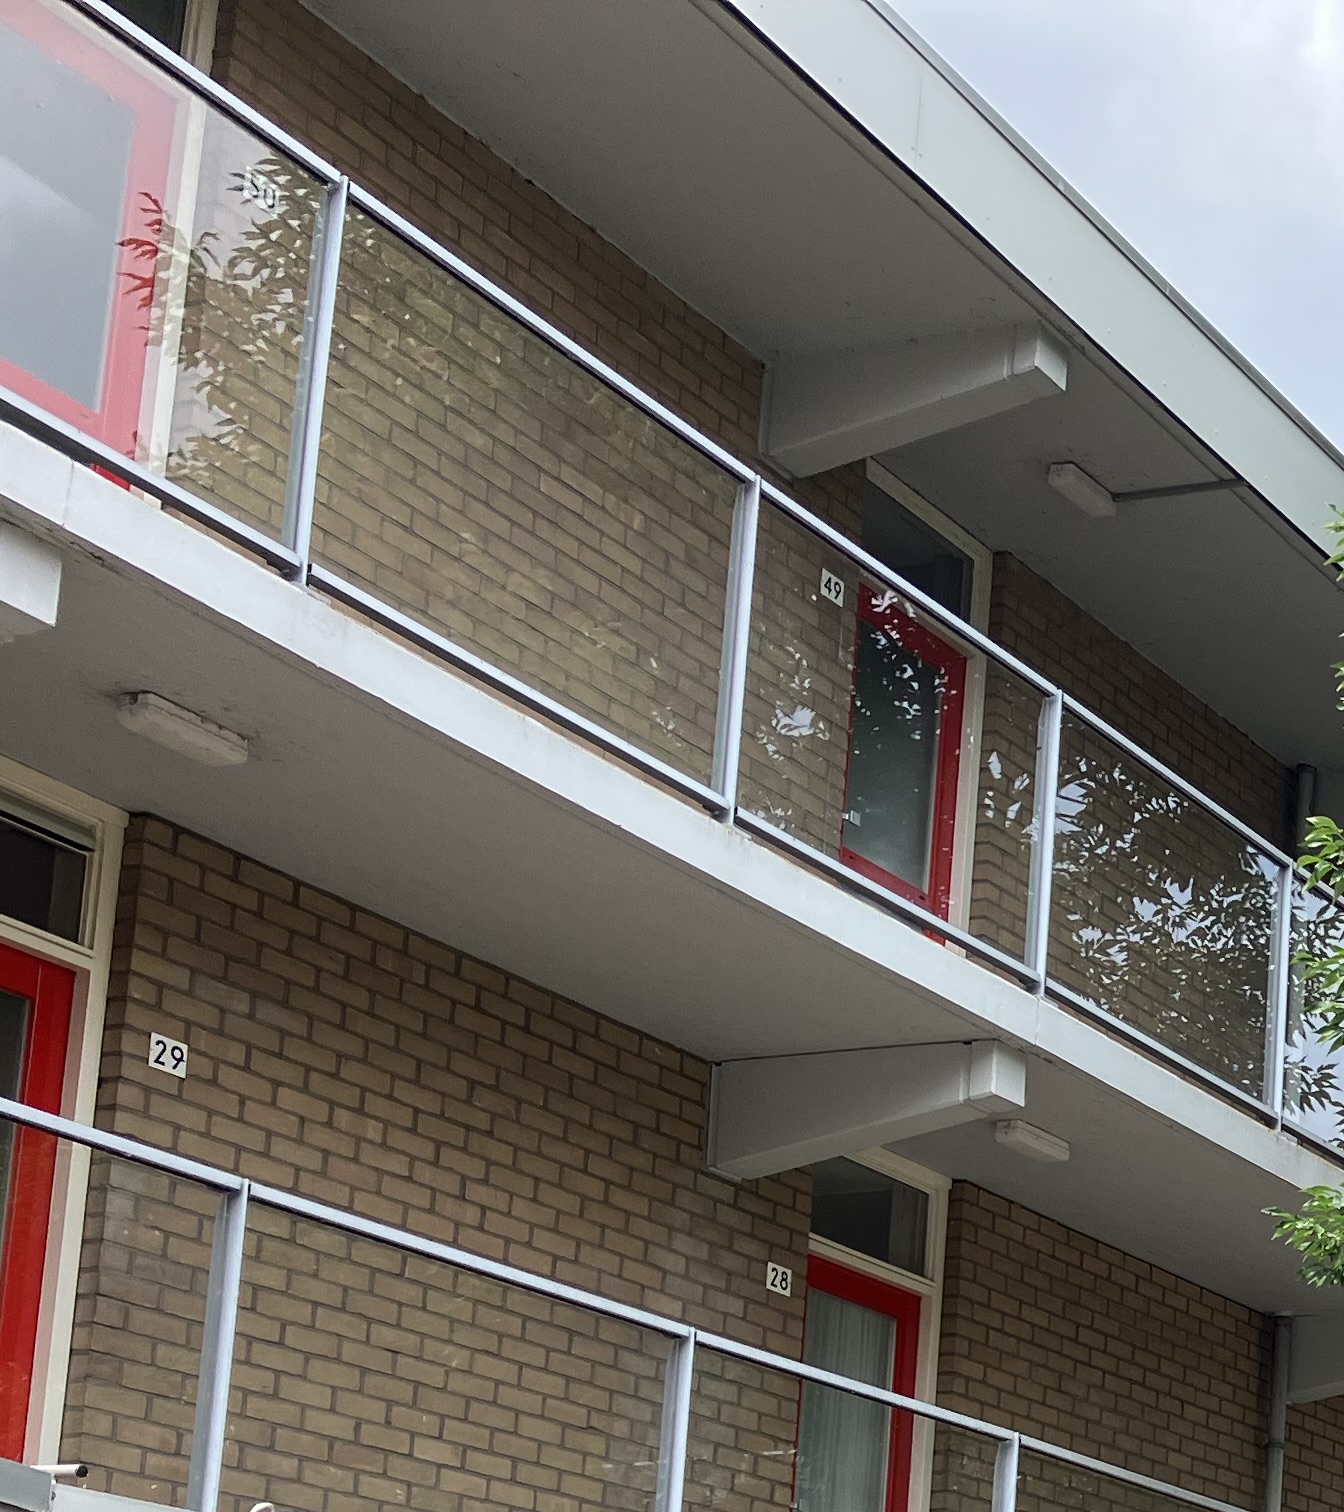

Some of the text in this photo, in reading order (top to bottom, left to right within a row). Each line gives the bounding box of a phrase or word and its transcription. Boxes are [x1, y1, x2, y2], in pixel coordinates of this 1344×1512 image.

[824, 576, 842, 600] 49
[154, 1040, 185, 1070] 29
[771, 1267, 788, 1290] 28
